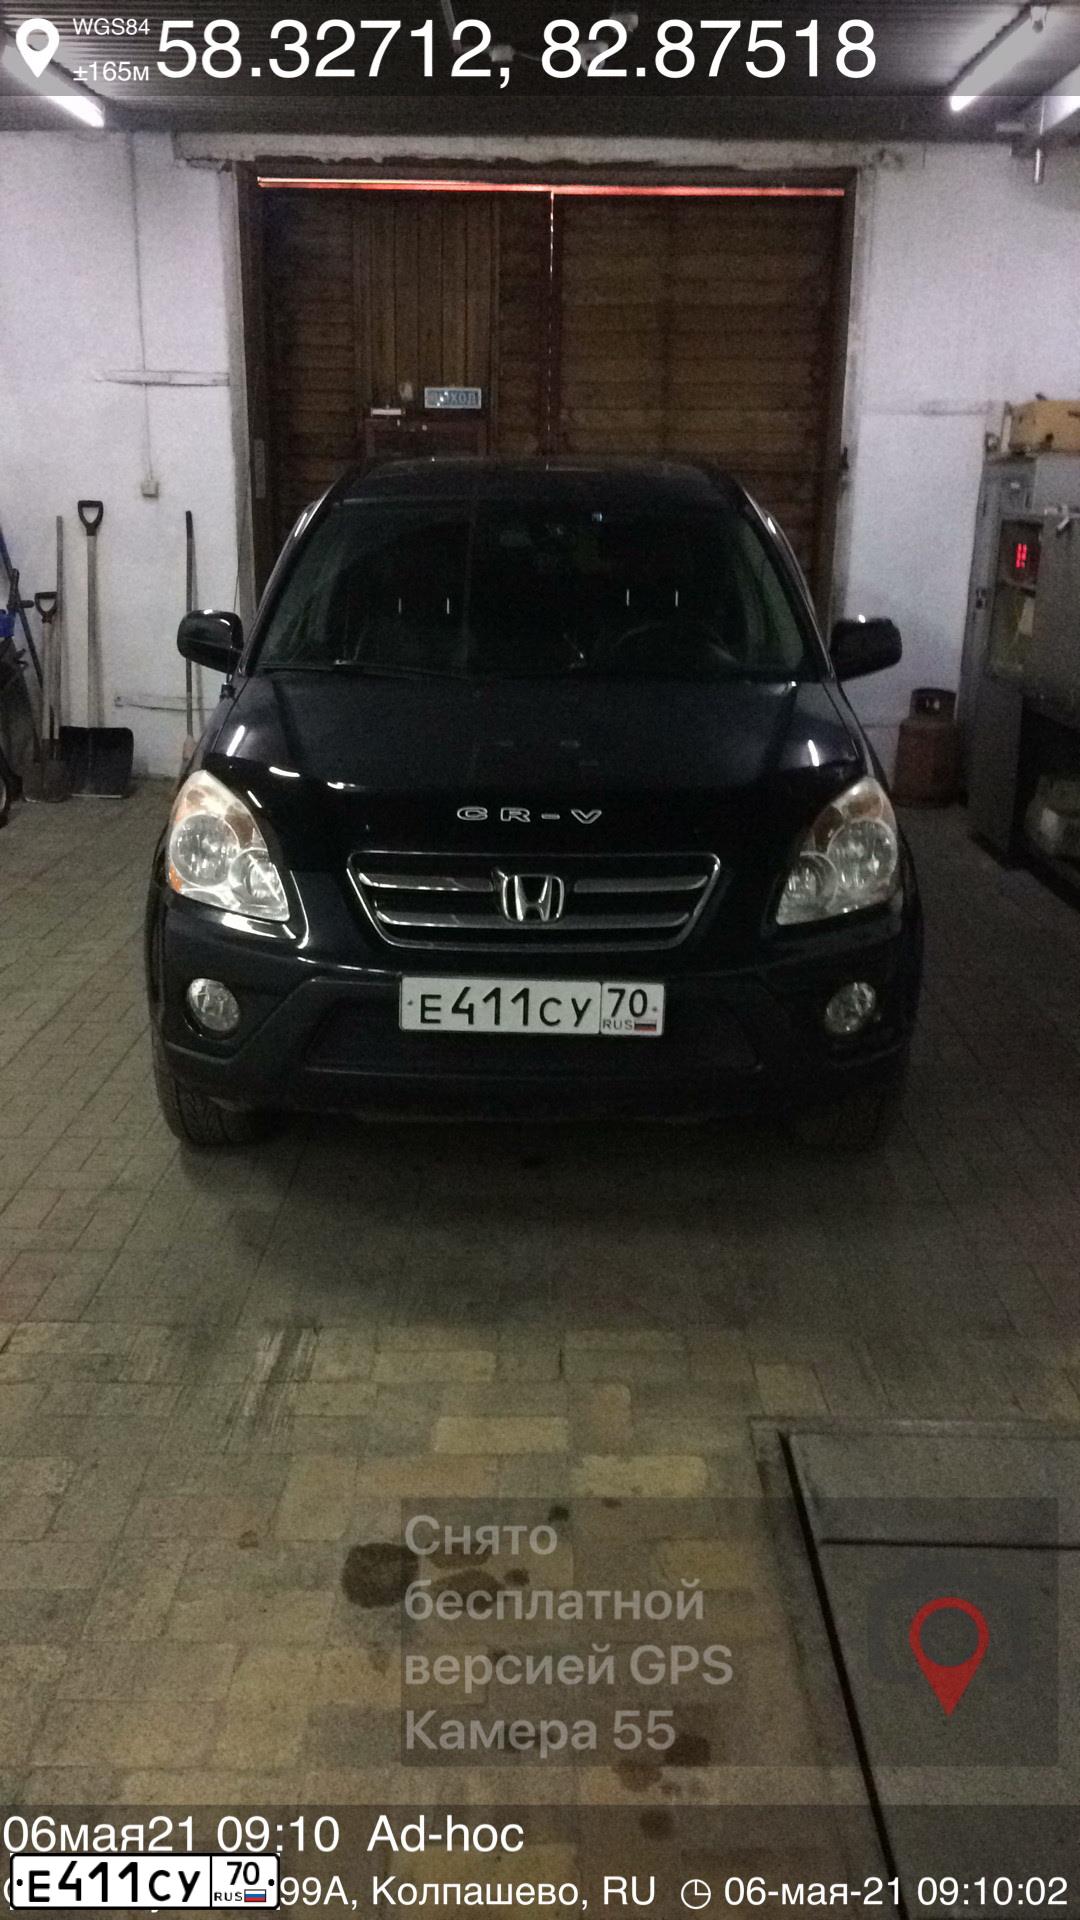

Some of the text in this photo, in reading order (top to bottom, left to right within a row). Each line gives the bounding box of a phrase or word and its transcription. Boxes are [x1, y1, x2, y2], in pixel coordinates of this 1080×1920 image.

[456, 806, 602, 824] CR-V
[607, 988, 648, 1018] 70
[602, 1019, 633, 1031] RUS
